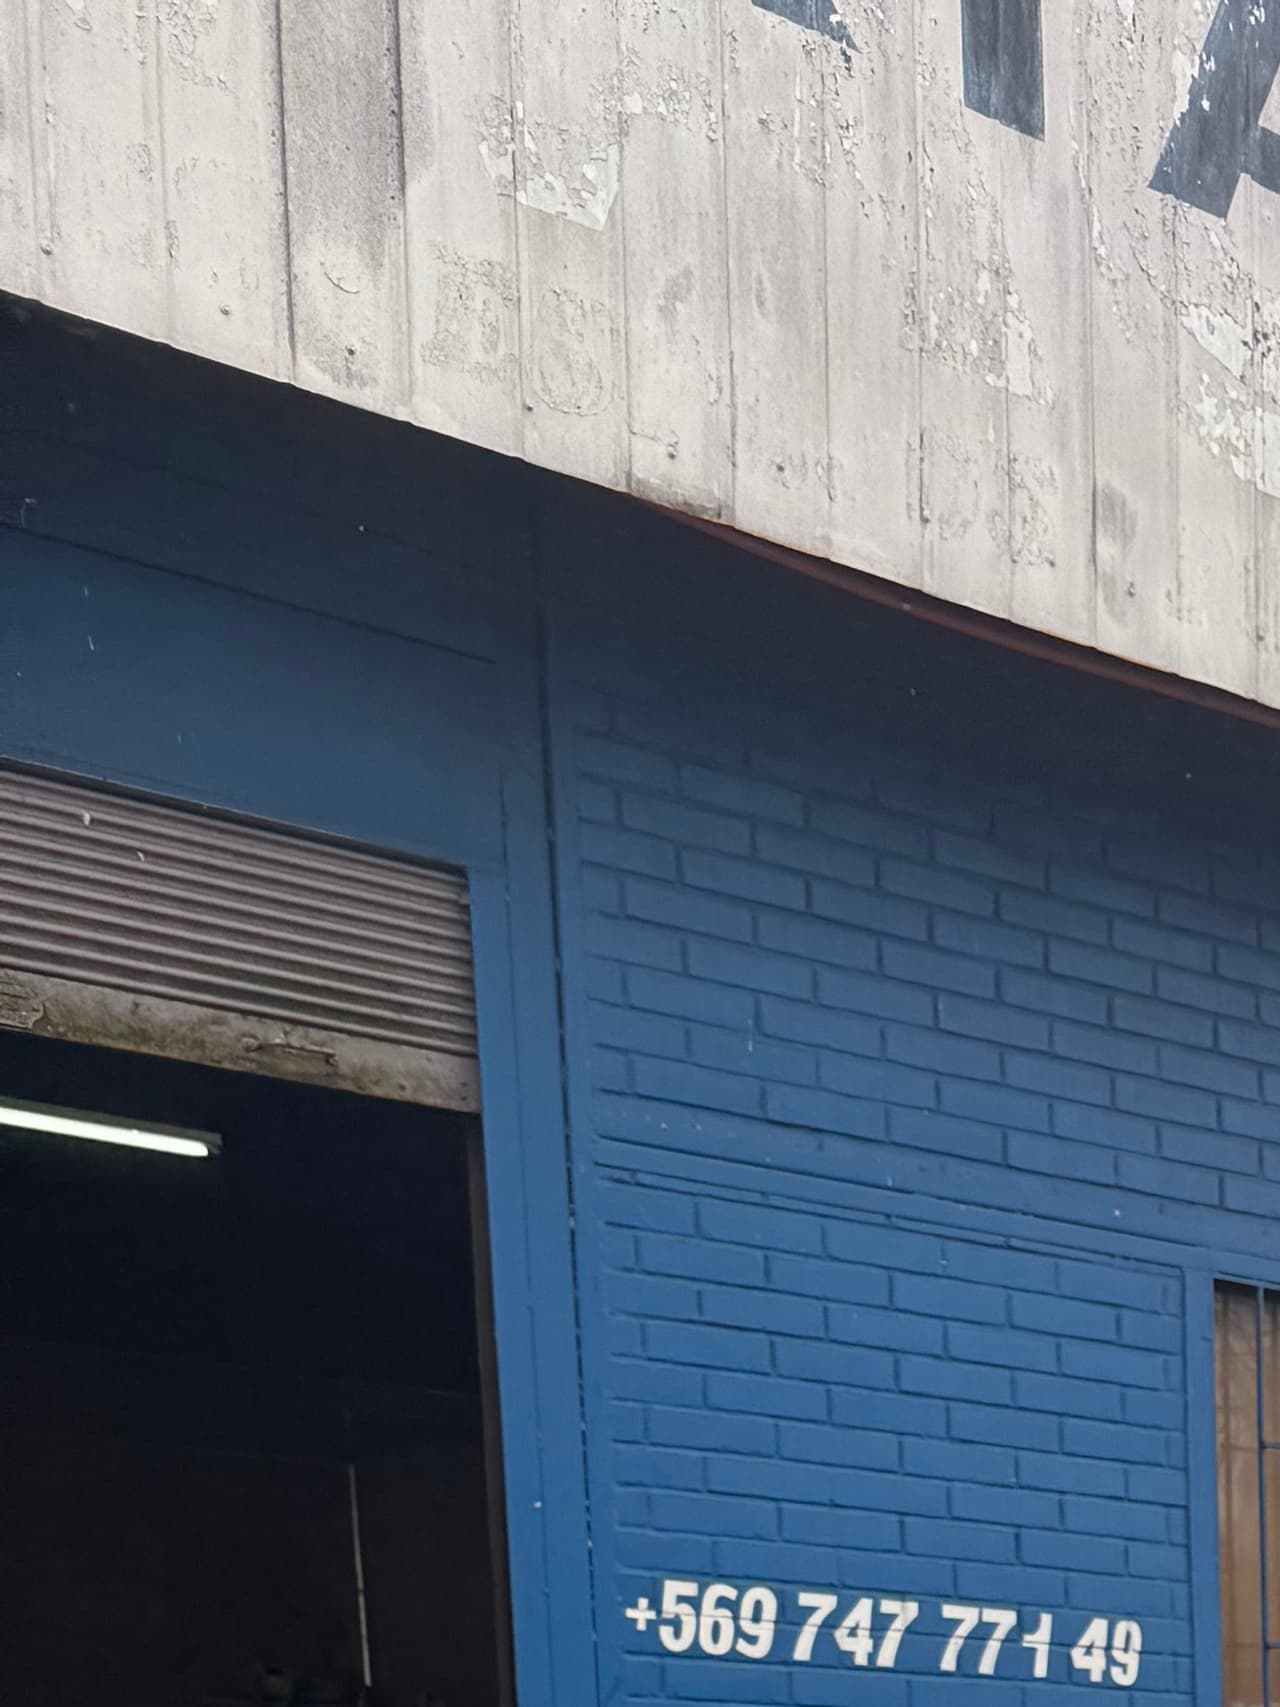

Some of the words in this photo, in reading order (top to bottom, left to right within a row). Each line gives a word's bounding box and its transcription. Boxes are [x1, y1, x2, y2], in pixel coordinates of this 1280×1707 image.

[625, 1579, 778, 1660] +569
[793, 1591, 919, 1668] 747
[939, 1603, 1053, 1678] 771
[1070, 1617, 1143, 1687] 49
